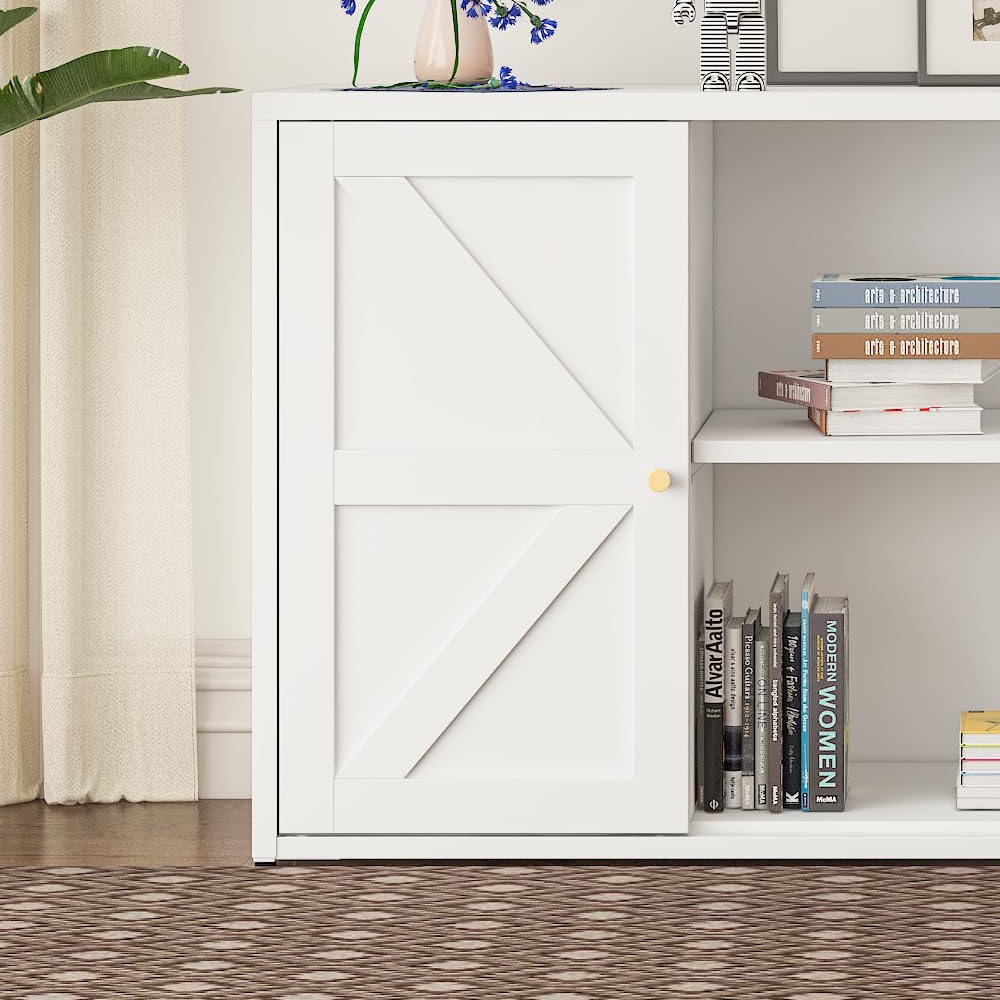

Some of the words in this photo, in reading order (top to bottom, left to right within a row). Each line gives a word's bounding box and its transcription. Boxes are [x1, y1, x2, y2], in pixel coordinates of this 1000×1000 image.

[865, 286, 884, 304] arts
[900, 285, 960, 304] architecture
[865, 312, 884, 330] arts
[900, 311, 960, 330] architecture
[865, 337, 884, 355] arts
[900, 336, 960, 355] architecture
[744, 635, 753, 666] Picasso
[826, 620, 837, 682] MODERN
[744, 667, 753, 700] Guitars
[818, 686, 837, 787] WOMEN
[758, 784, 766, 804] MoMA
[816, 795, 837, 803] MoMA
